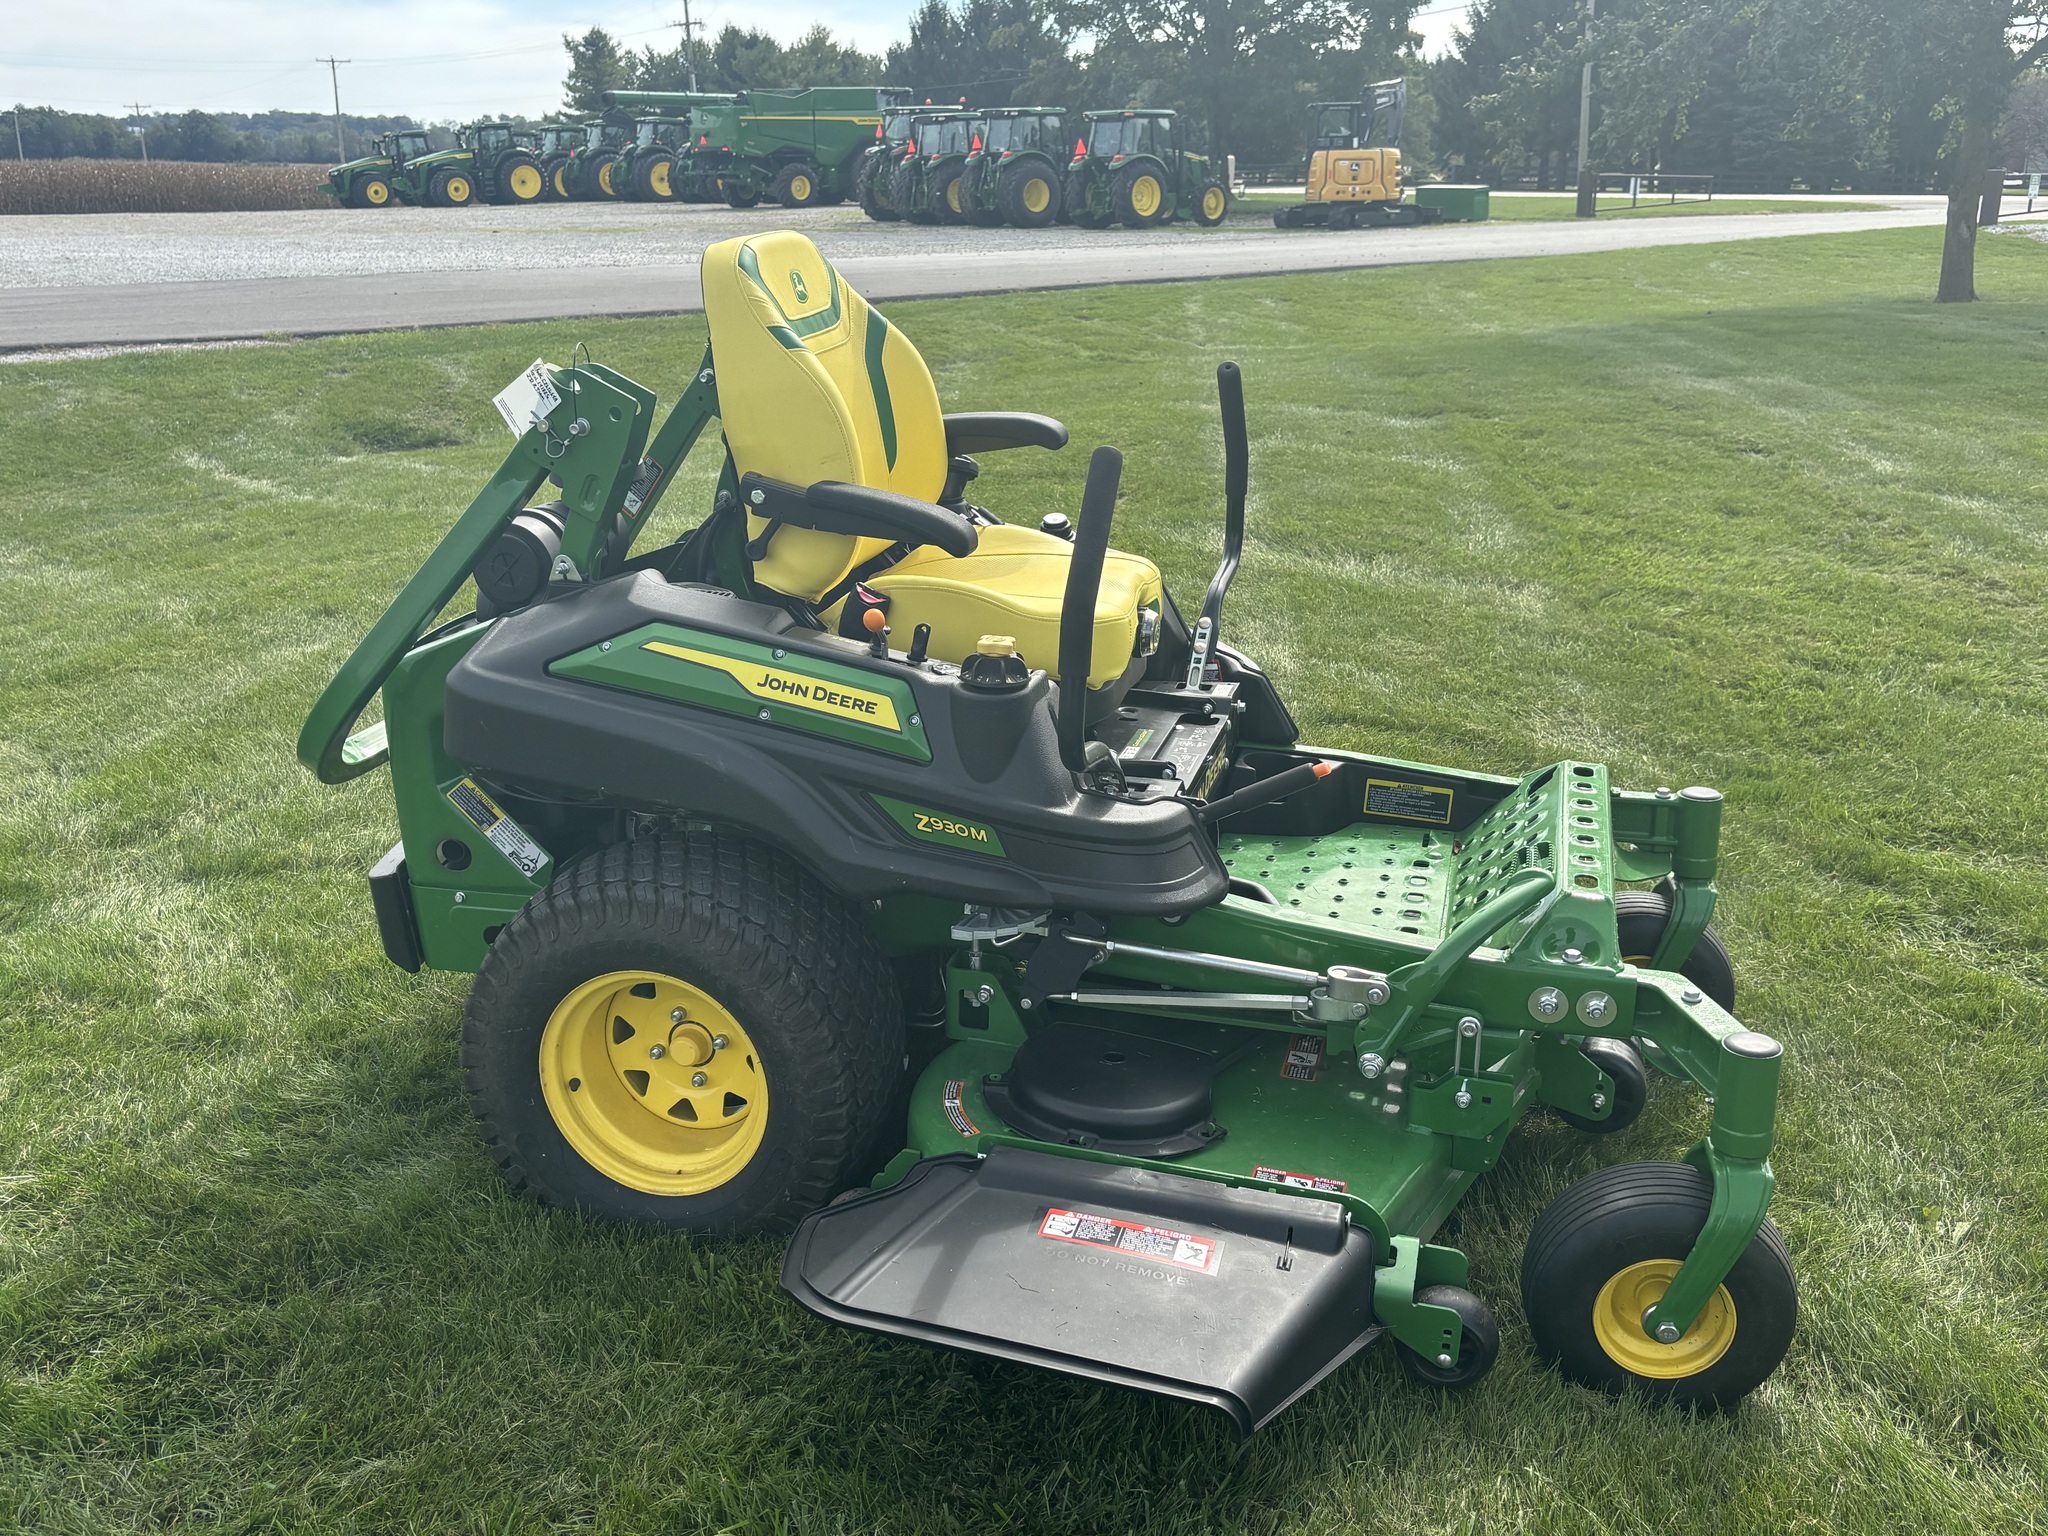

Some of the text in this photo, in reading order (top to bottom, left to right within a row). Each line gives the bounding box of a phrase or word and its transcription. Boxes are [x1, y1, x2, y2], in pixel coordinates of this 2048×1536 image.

[757, 674, 878, 715] JOHN DEERE
[475, 789, 496, 811] CAUTION
[1262, 1167, 1287, 1176] DANGER
[1319, 1177, 1346, 1187] PELIGRO
[1076, 1213, 1112, 1224] DANGER
[1153, 1228, 1192, 1241] PELIGRO
[1045, 1246, 1187, 1286] DO NOT REMOVE
